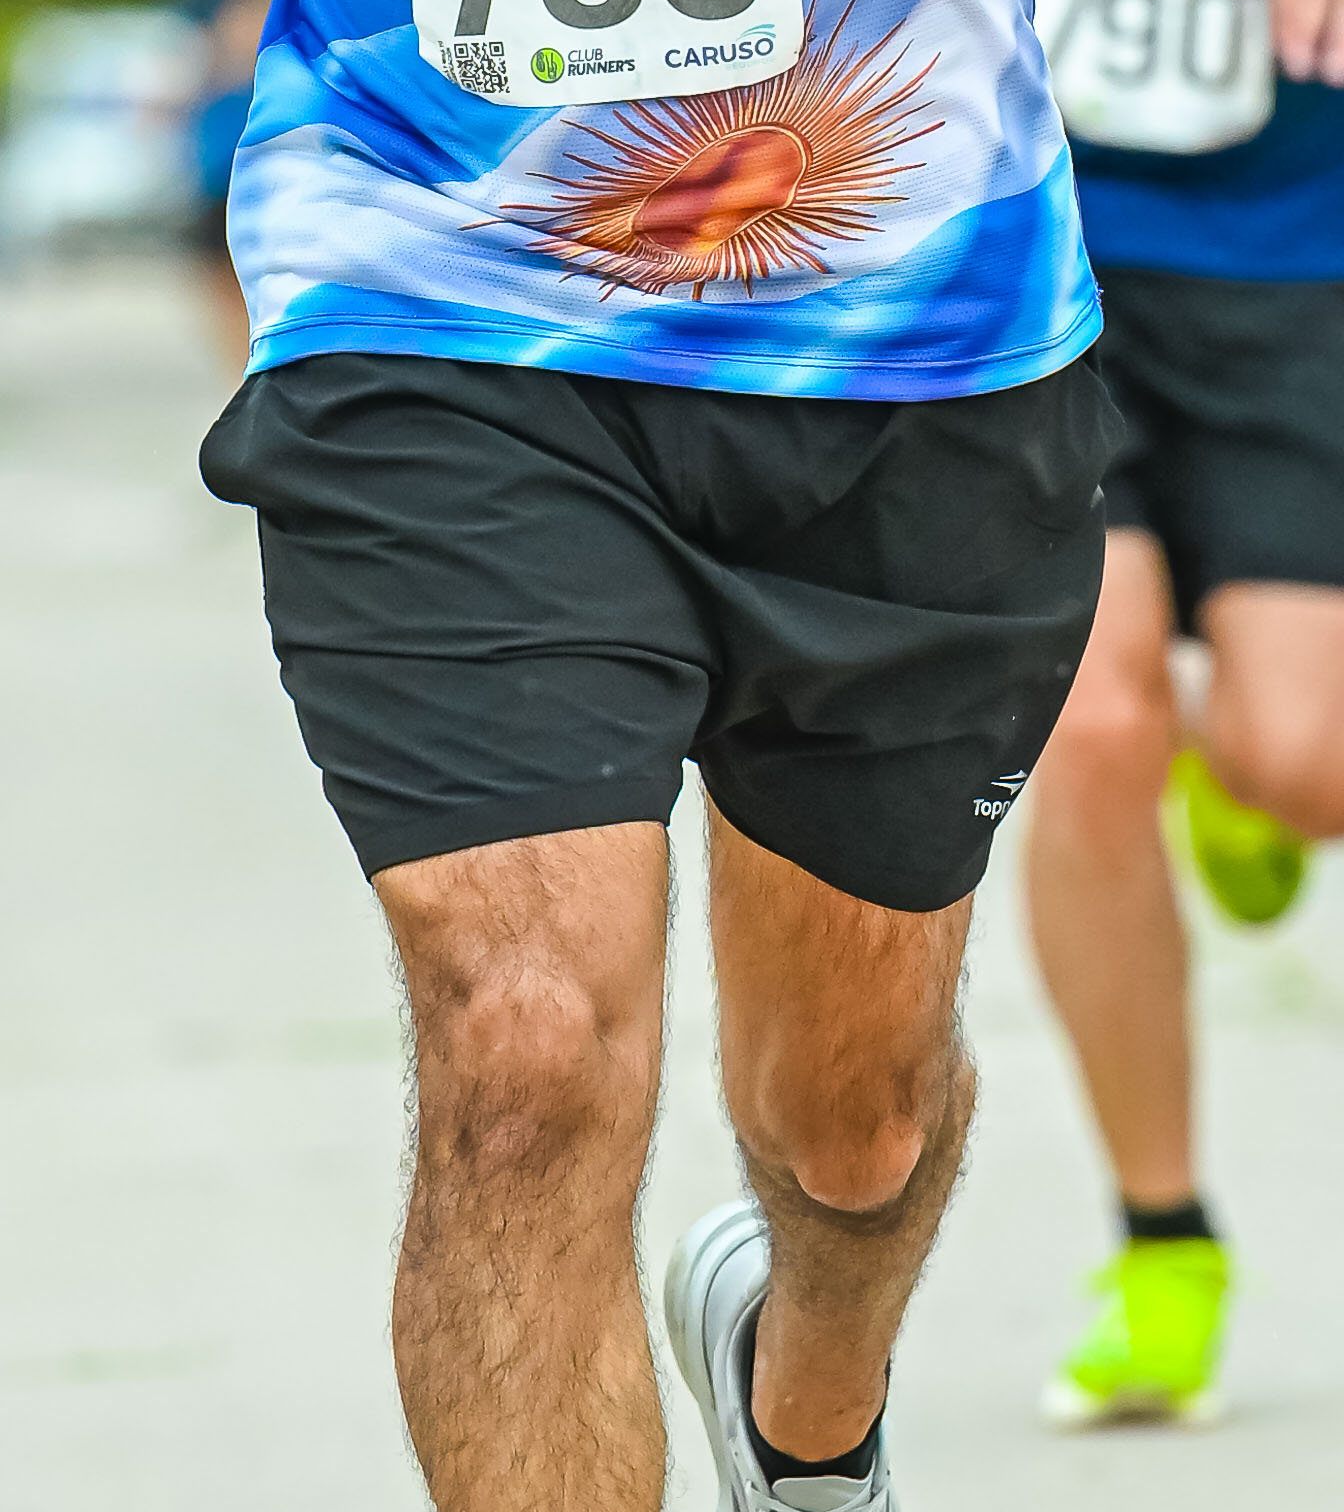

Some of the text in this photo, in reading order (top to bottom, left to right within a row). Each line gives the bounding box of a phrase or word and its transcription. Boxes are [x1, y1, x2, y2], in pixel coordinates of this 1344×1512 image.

[568, 48, 603, 63] CLUB
[665, 37, 774, 68] CARUSO
[568, 59, 636, 76] RUNNER'S
